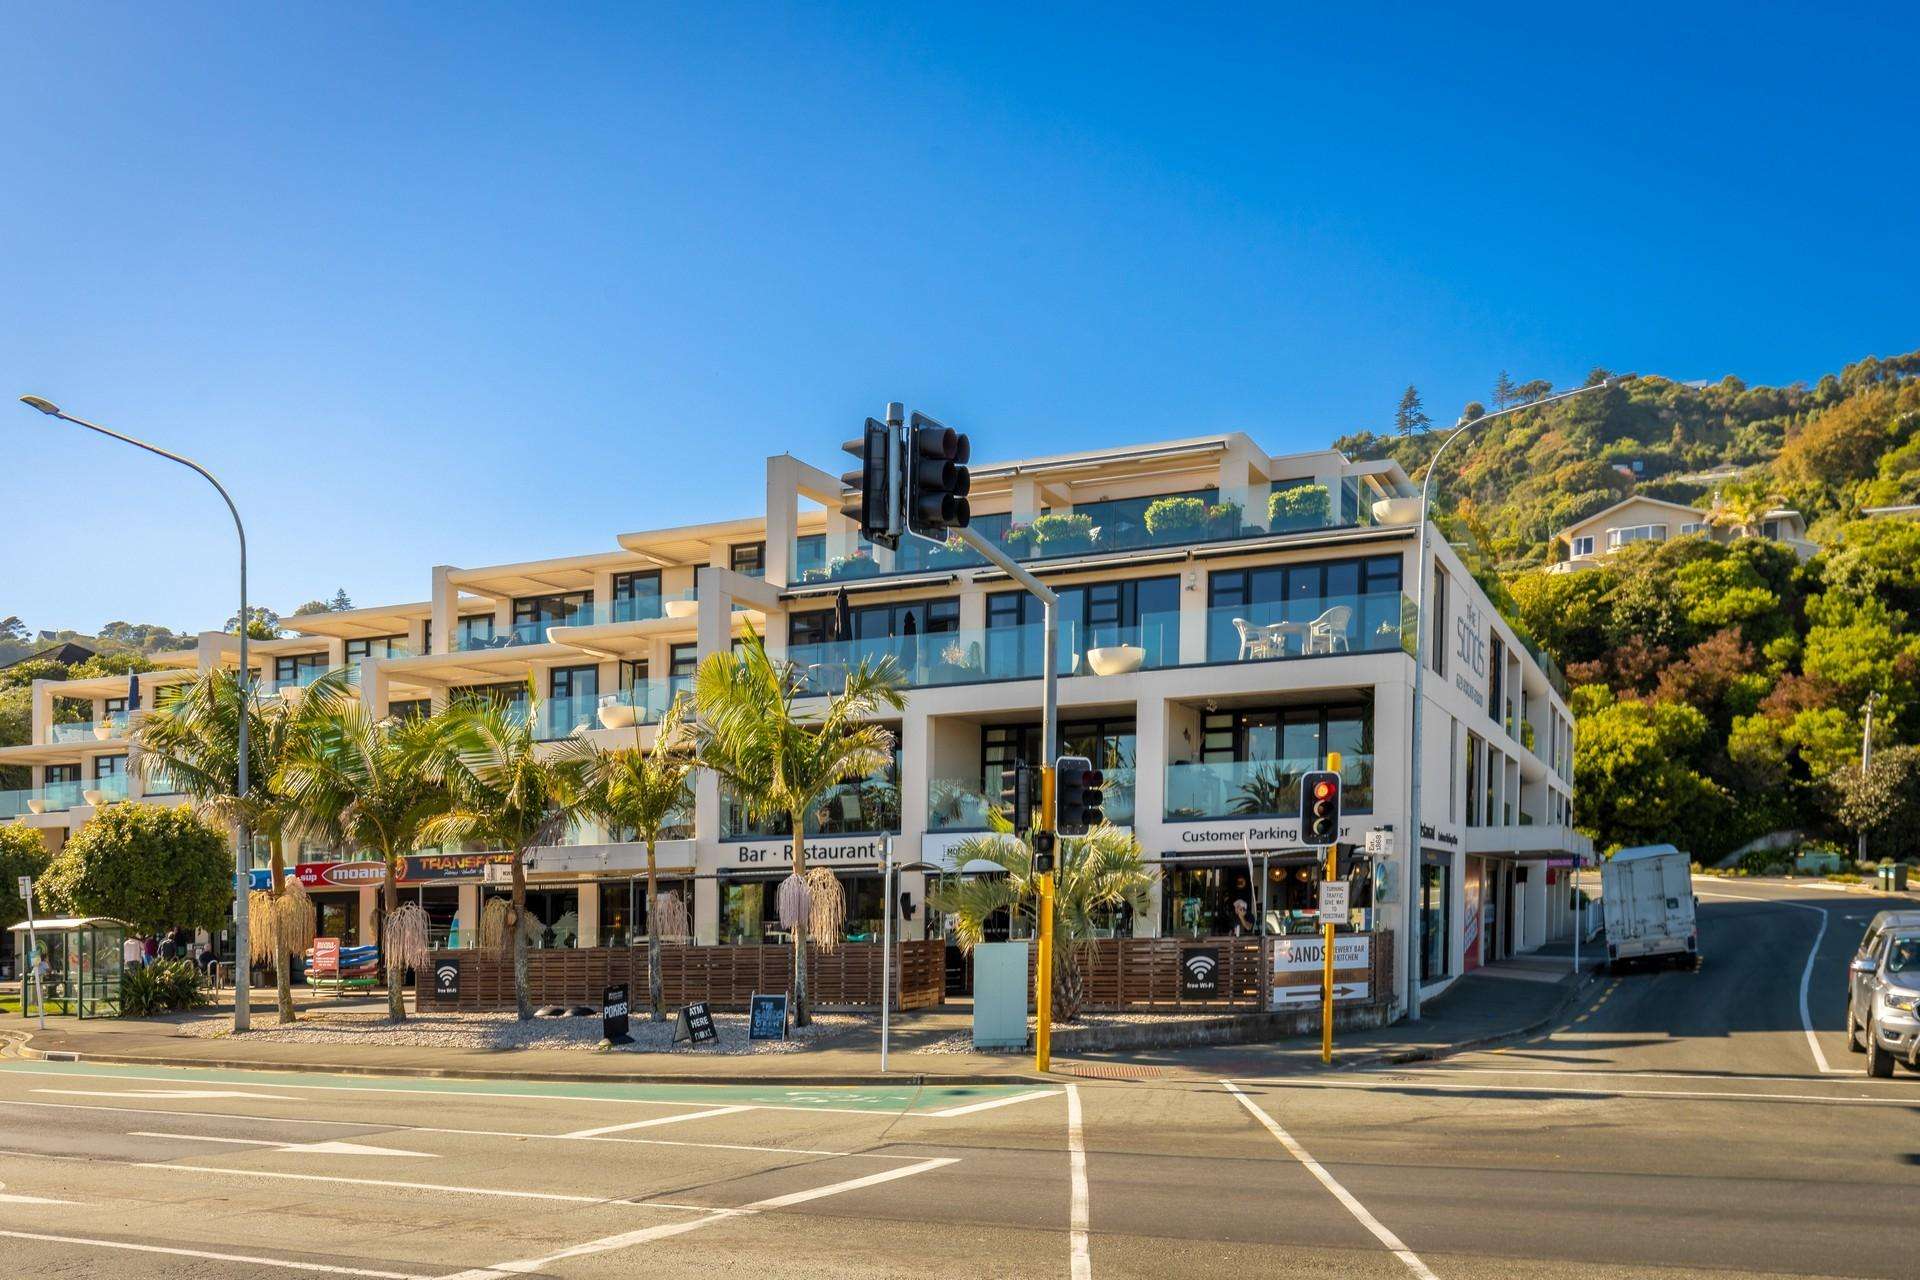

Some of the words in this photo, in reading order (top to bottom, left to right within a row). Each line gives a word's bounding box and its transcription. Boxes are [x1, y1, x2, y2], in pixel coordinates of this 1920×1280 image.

[1182, 830, 1245, 842] Customer
[1249, 826, 1297, 841] Parking
[739, 846, 767, 861] Bar
[783, 842, 876, 861] Rstaurant
[300, 873, 318, 883] sup
[333, 867, 387, 880] moana
[1288, 945, 1326, 963] SANDS
[604, 1002, 628, 1020] POKIES
[689, 1005, 704, 1017] ATM
[690, 1016, 709, 1029] HERE
